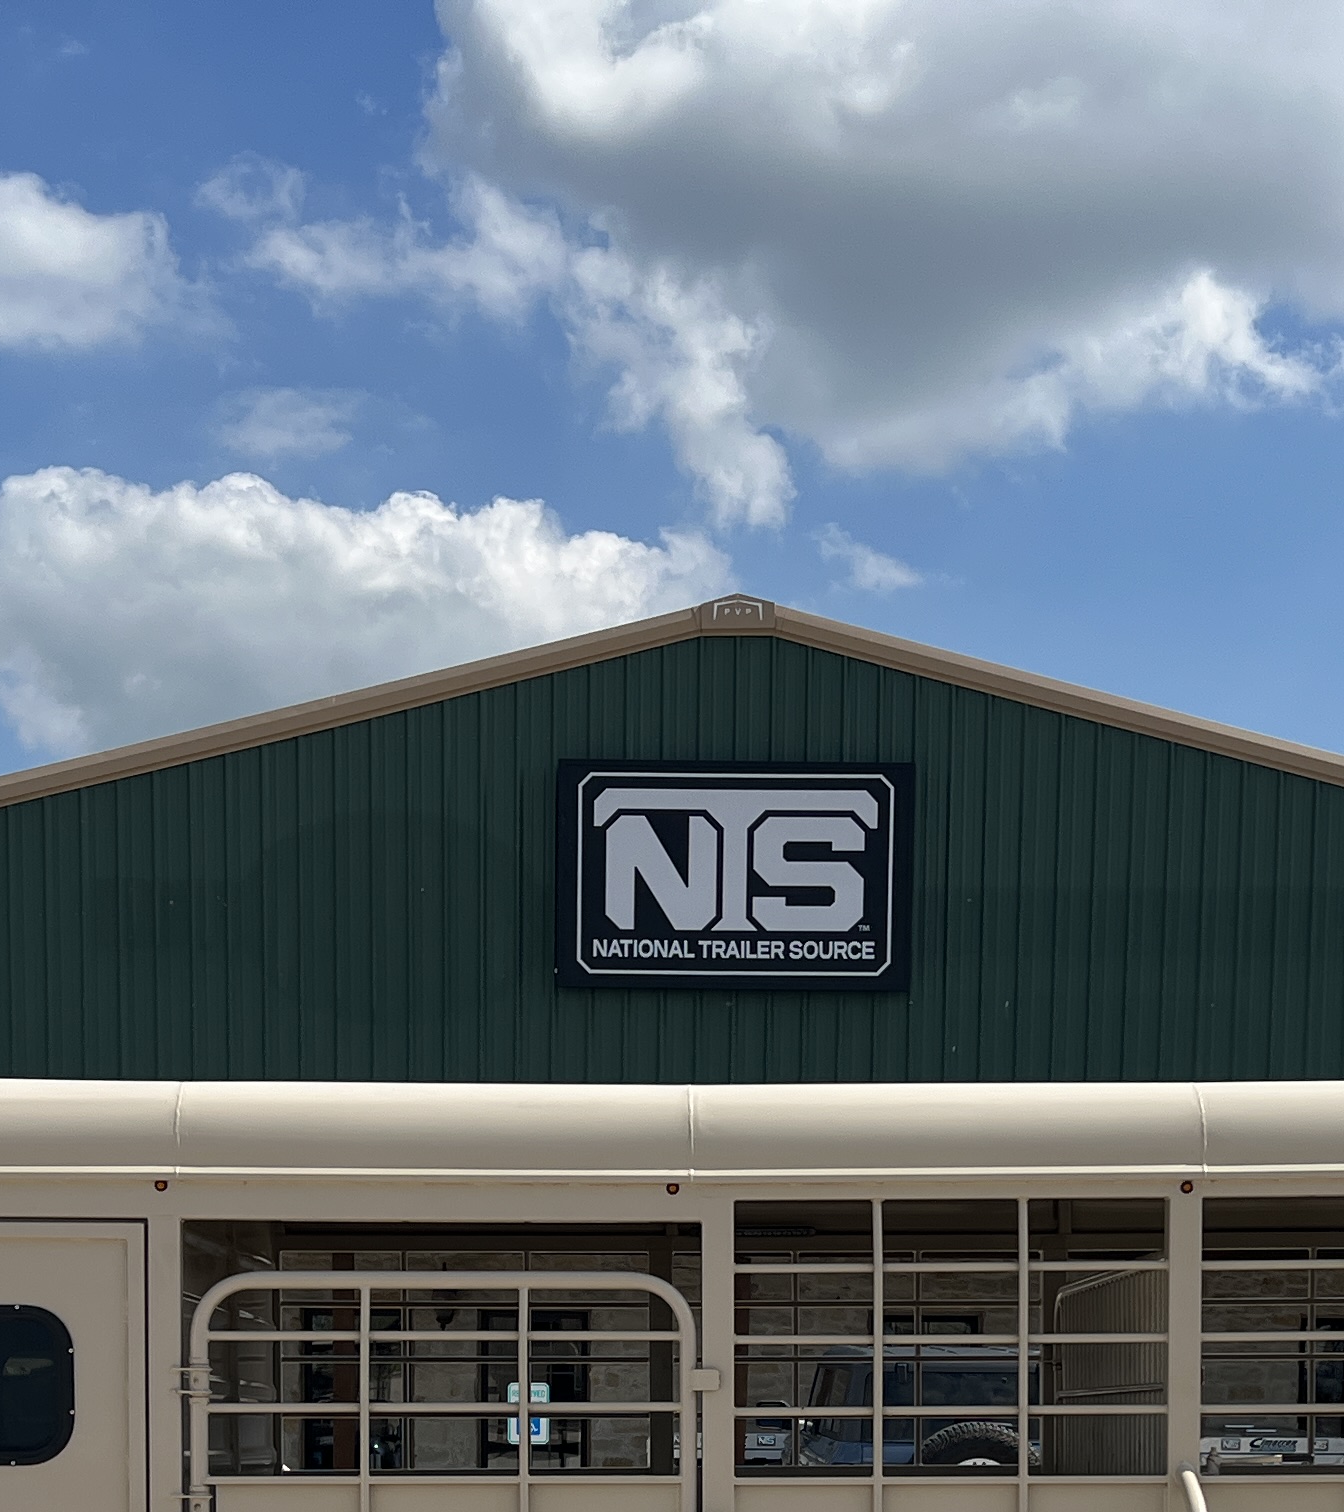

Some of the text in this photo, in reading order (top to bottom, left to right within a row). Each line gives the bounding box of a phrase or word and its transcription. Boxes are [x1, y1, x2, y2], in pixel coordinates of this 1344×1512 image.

[594, 788, 878, 932] NTS
[592, 938, 876, 960] NATIONAL TRAILER SOURCE
